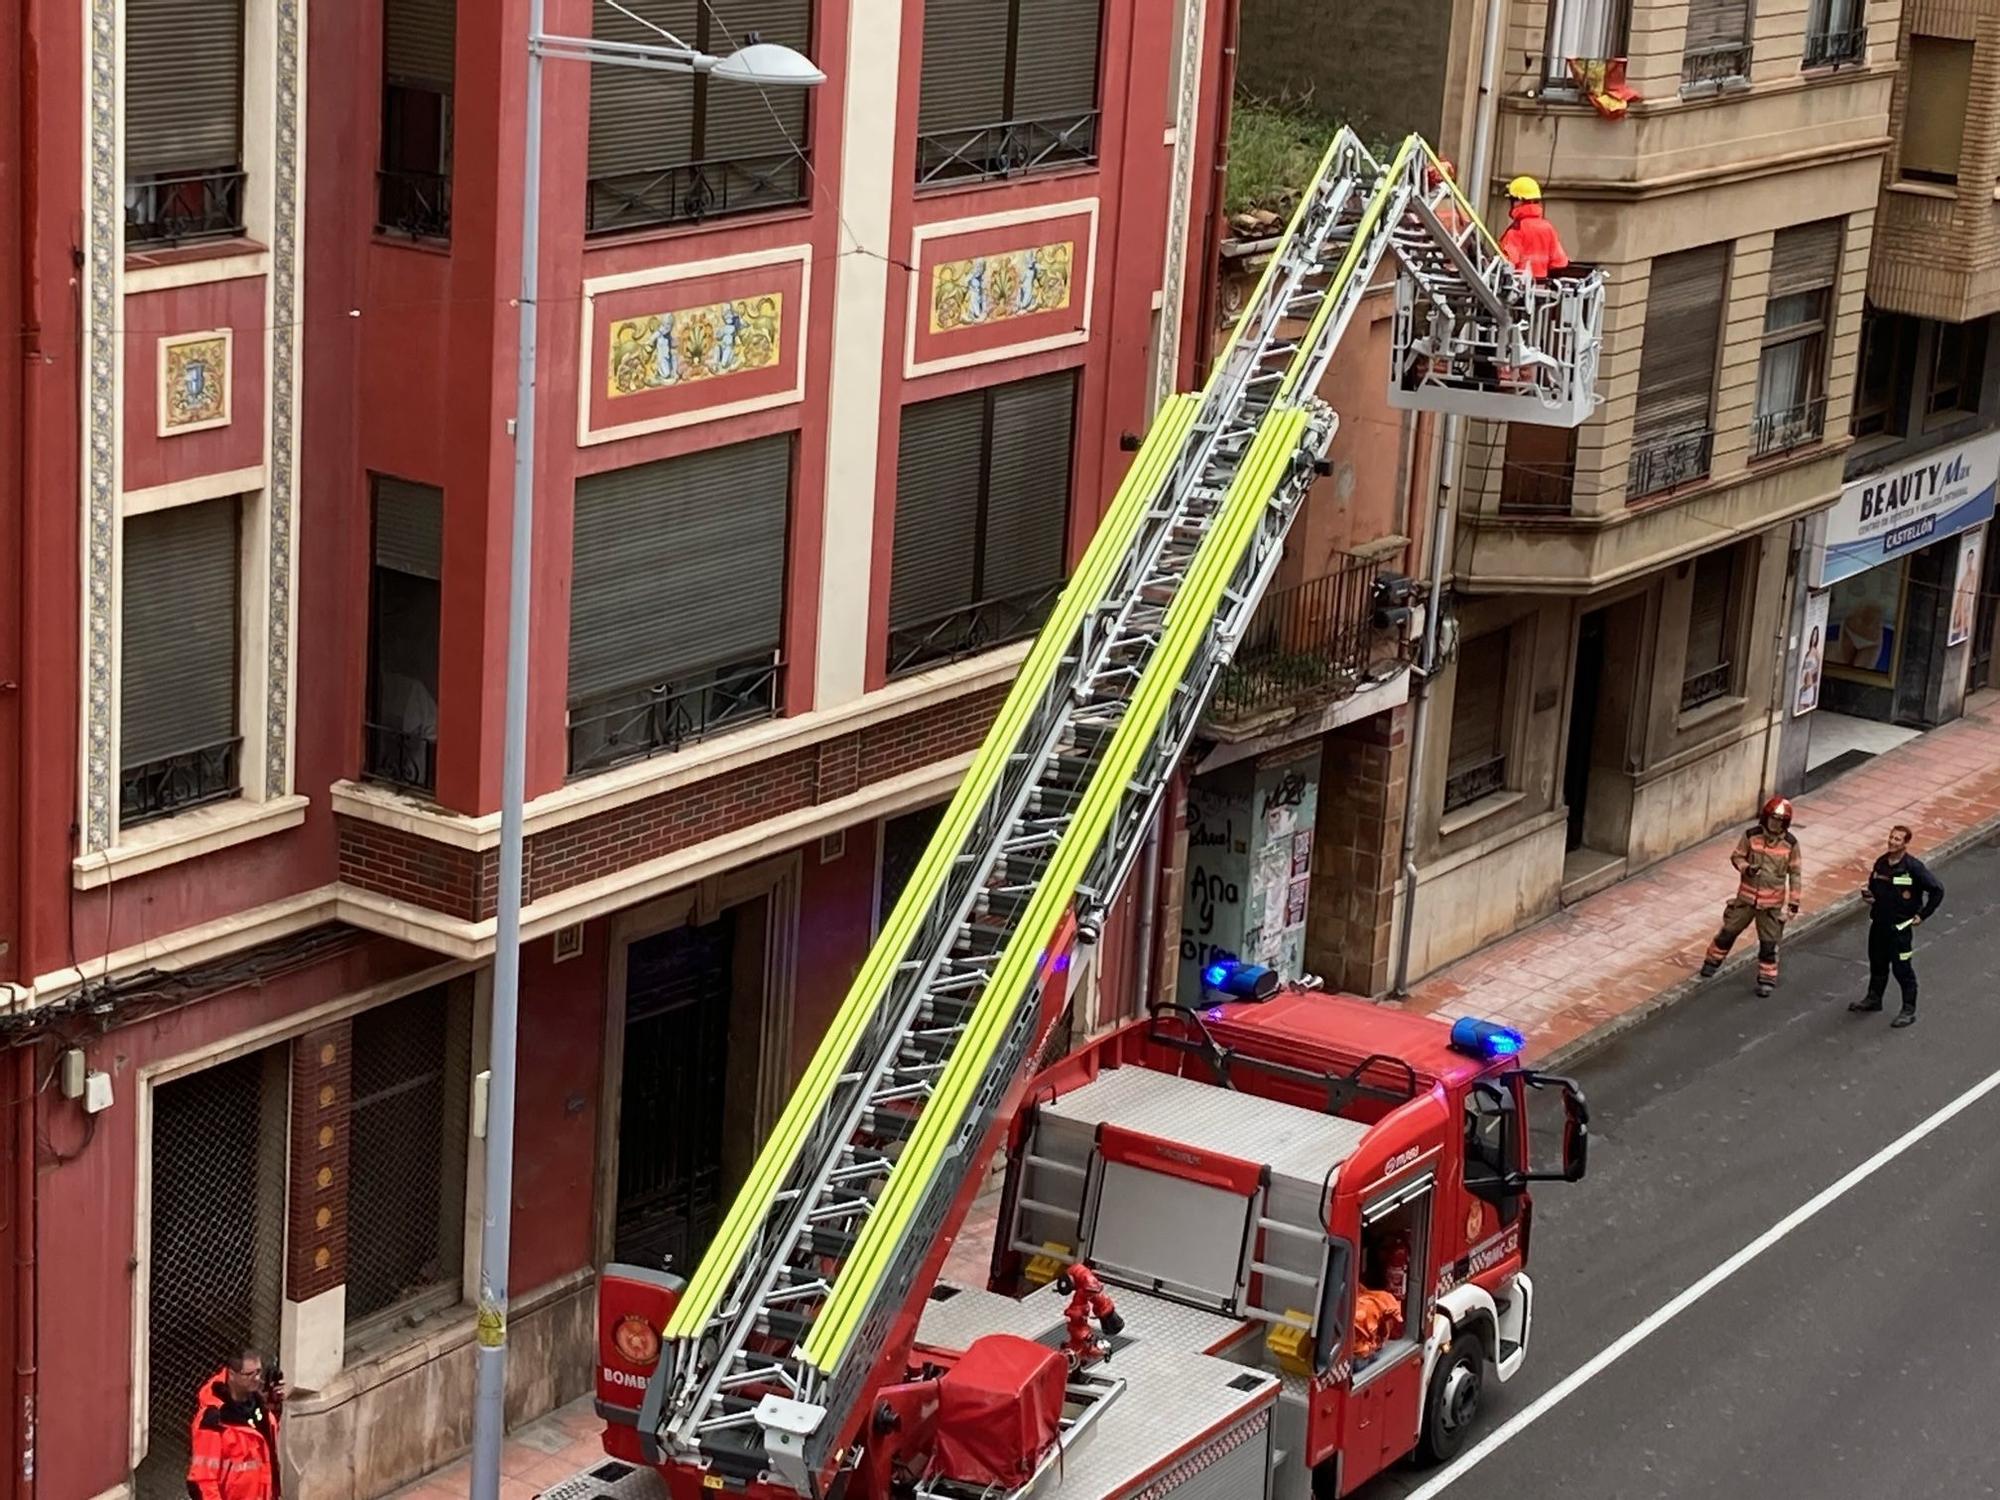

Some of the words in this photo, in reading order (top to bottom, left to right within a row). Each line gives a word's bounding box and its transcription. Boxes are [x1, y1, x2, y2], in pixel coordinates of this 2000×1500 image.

[1860, 462, 1941, 522] BEAUTY
[1886, 517, 1934, 549] CASTELLÓN
[1190, 865, 1239, 904] Ana
[603, 1367, 652, 1390] BOMB
